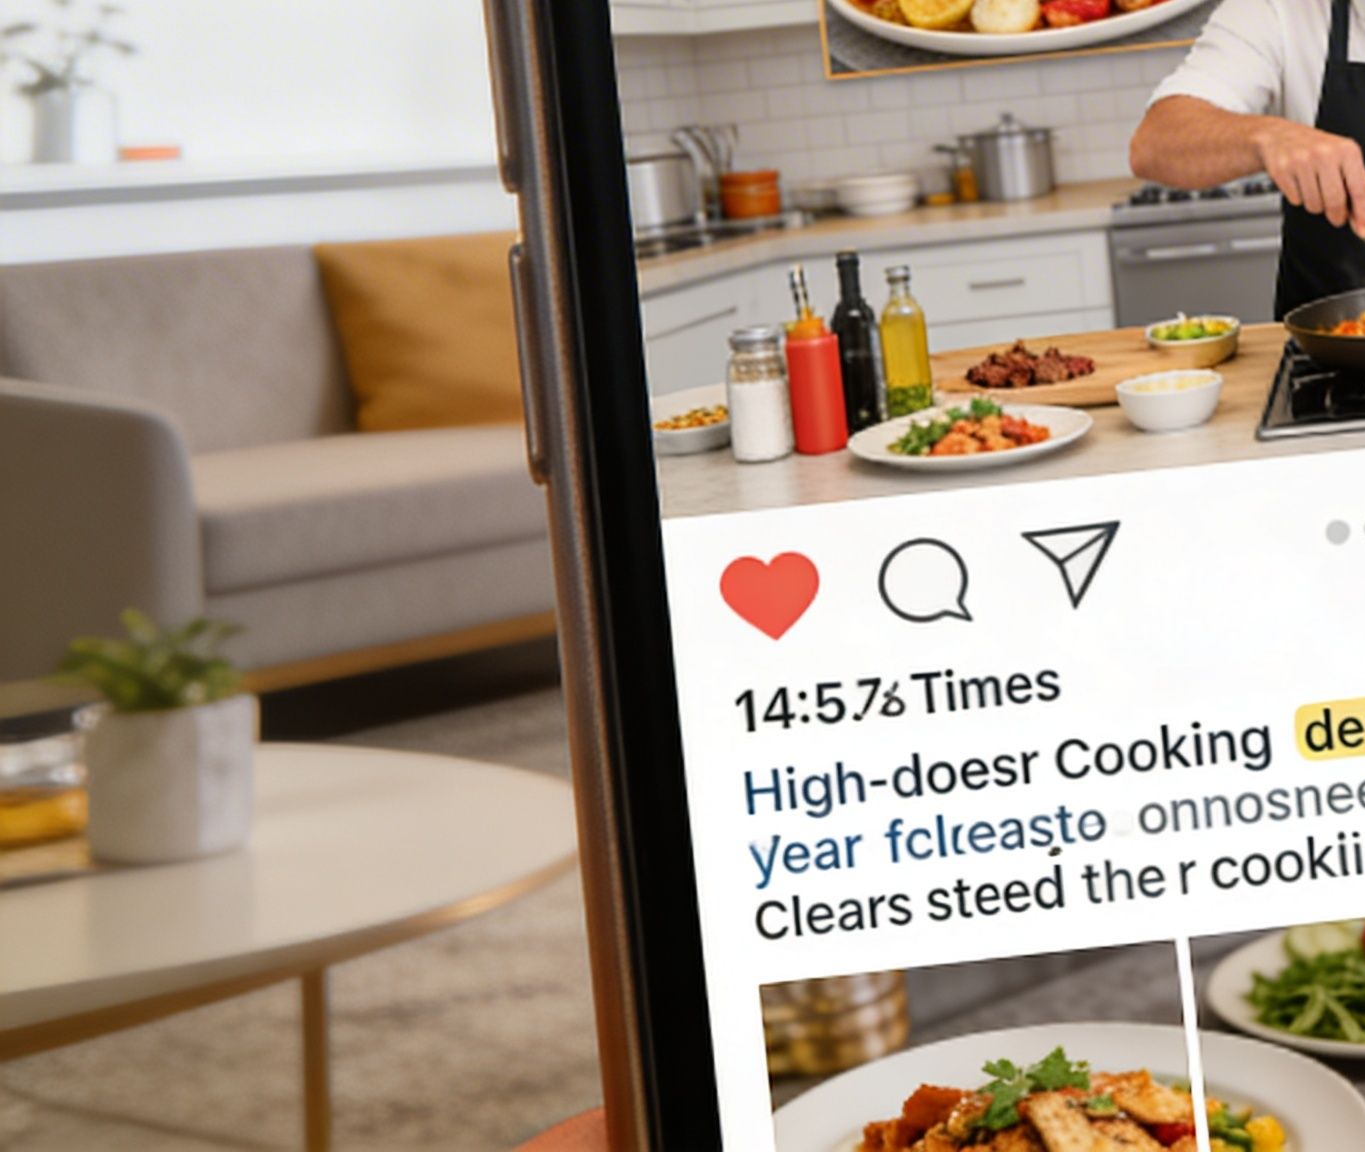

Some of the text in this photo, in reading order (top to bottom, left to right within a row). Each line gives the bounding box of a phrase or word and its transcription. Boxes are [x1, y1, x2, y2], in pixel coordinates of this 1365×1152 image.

[910, 668, 1061, 715] Times
[744, 750, 1039, 818] High-doesr
[1054, 723, 1272, 781] Cooking
[749, 834, 863, 890] year
[755, 890, 912, 940] Clears
[927, 864, 1064, 922] steed
